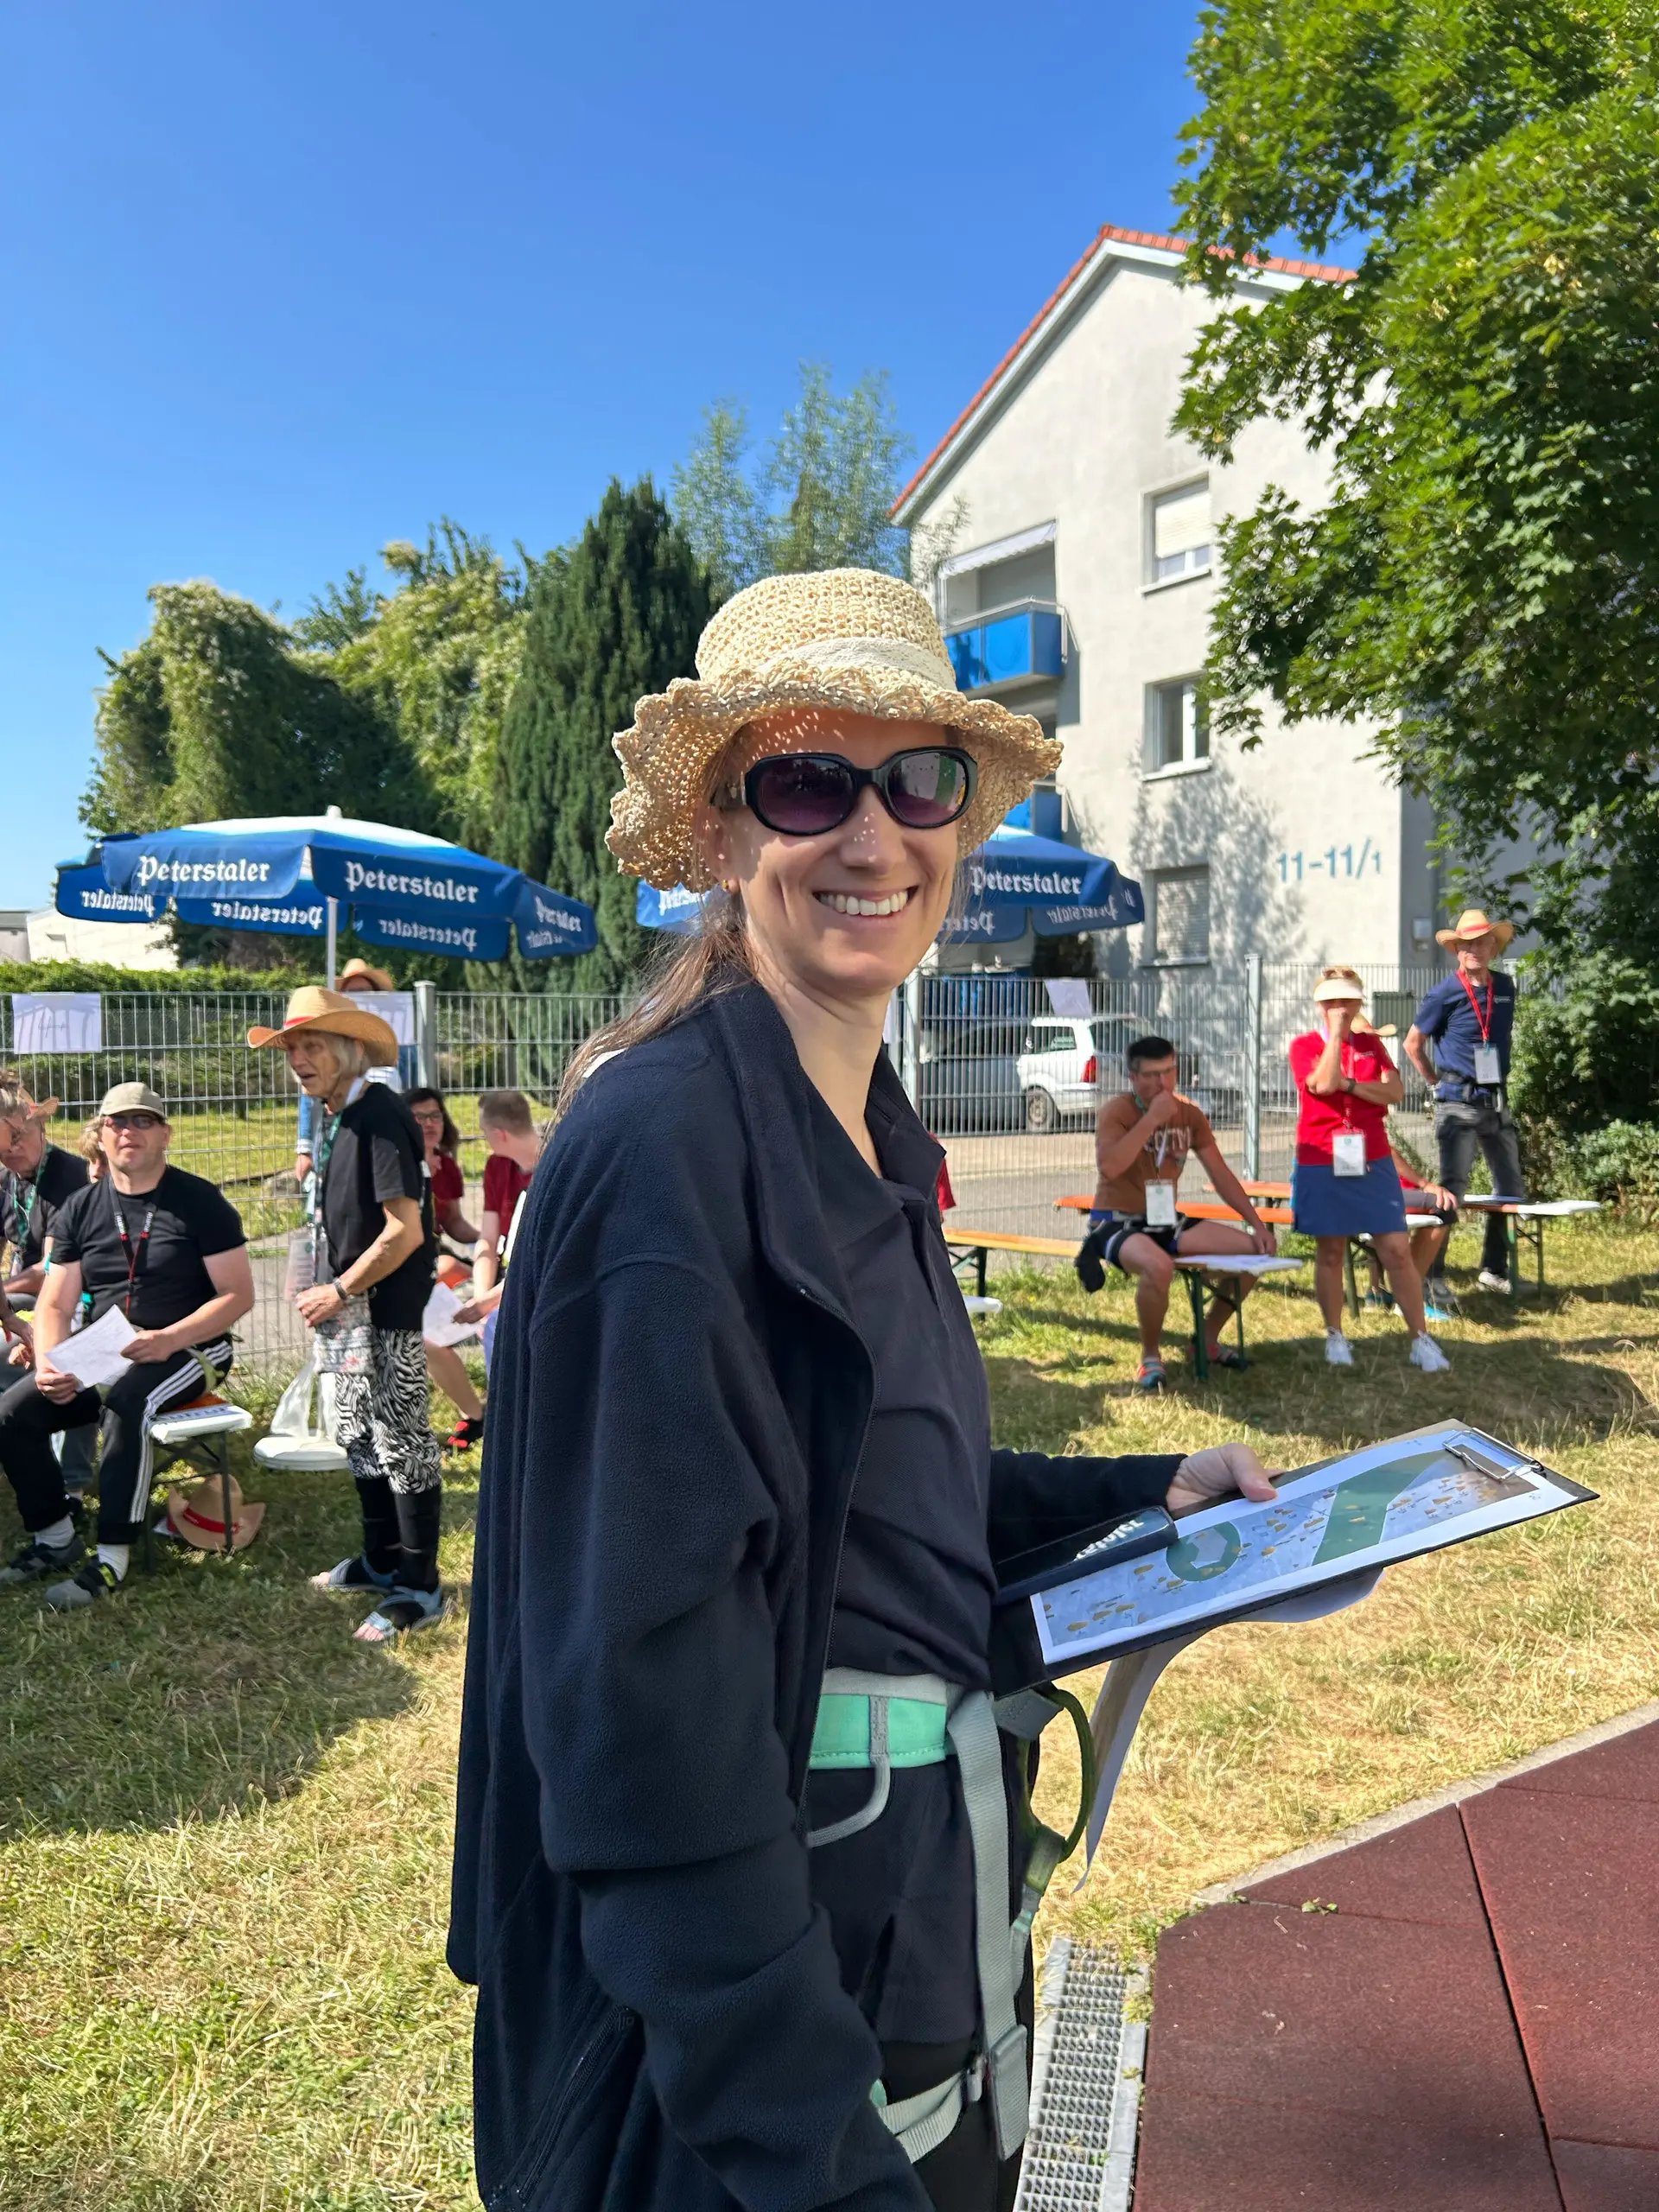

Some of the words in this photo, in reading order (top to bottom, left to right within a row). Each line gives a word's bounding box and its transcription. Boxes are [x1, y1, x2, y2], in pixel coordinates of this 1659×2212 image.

[138, 855, 270, 886] Peterstaler
[345, 861, 479, 903] Peterstaler
[970, 866, 1082, 896] Peterstaler
